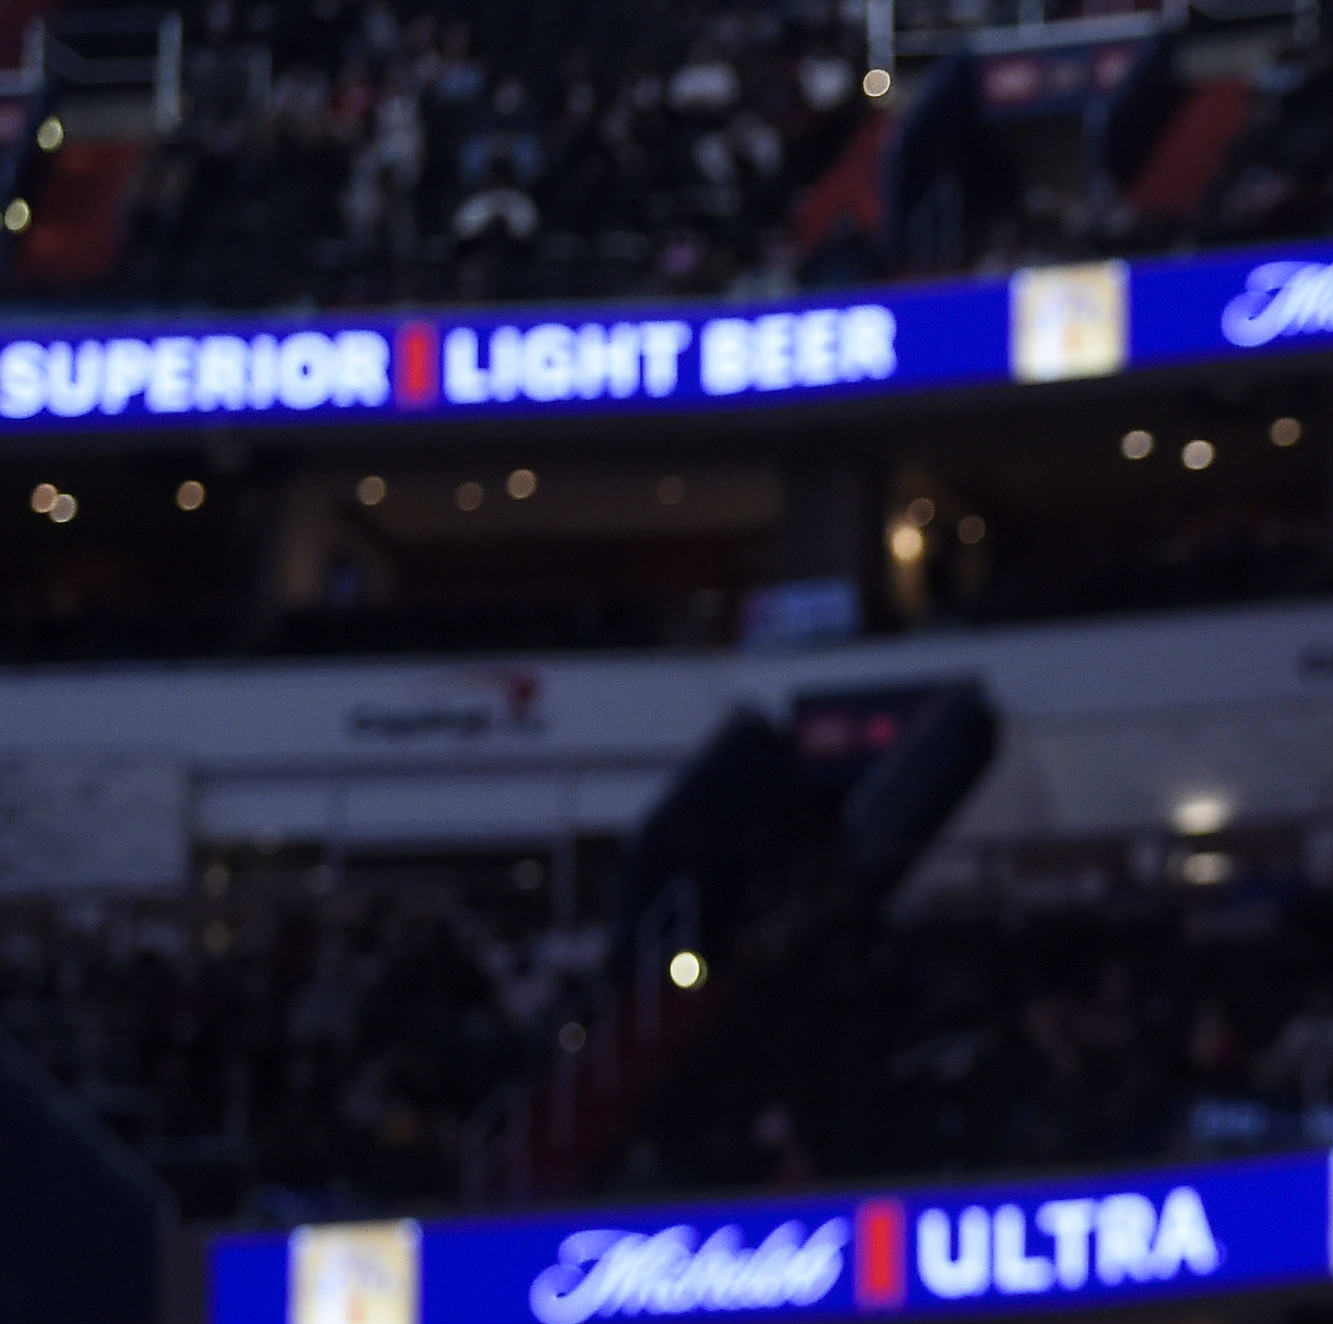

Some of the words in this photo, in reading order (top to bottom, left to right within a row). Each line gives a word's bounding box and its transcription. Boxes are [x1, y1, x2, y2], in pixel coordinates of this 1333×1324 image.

[0, 329, 391, 419] SUPERIOR
[442, 320, 693, 404] LIGHT
[701, 304, 897, 396] BEER
[916, 1185, 1218, 1299] ULTRA
